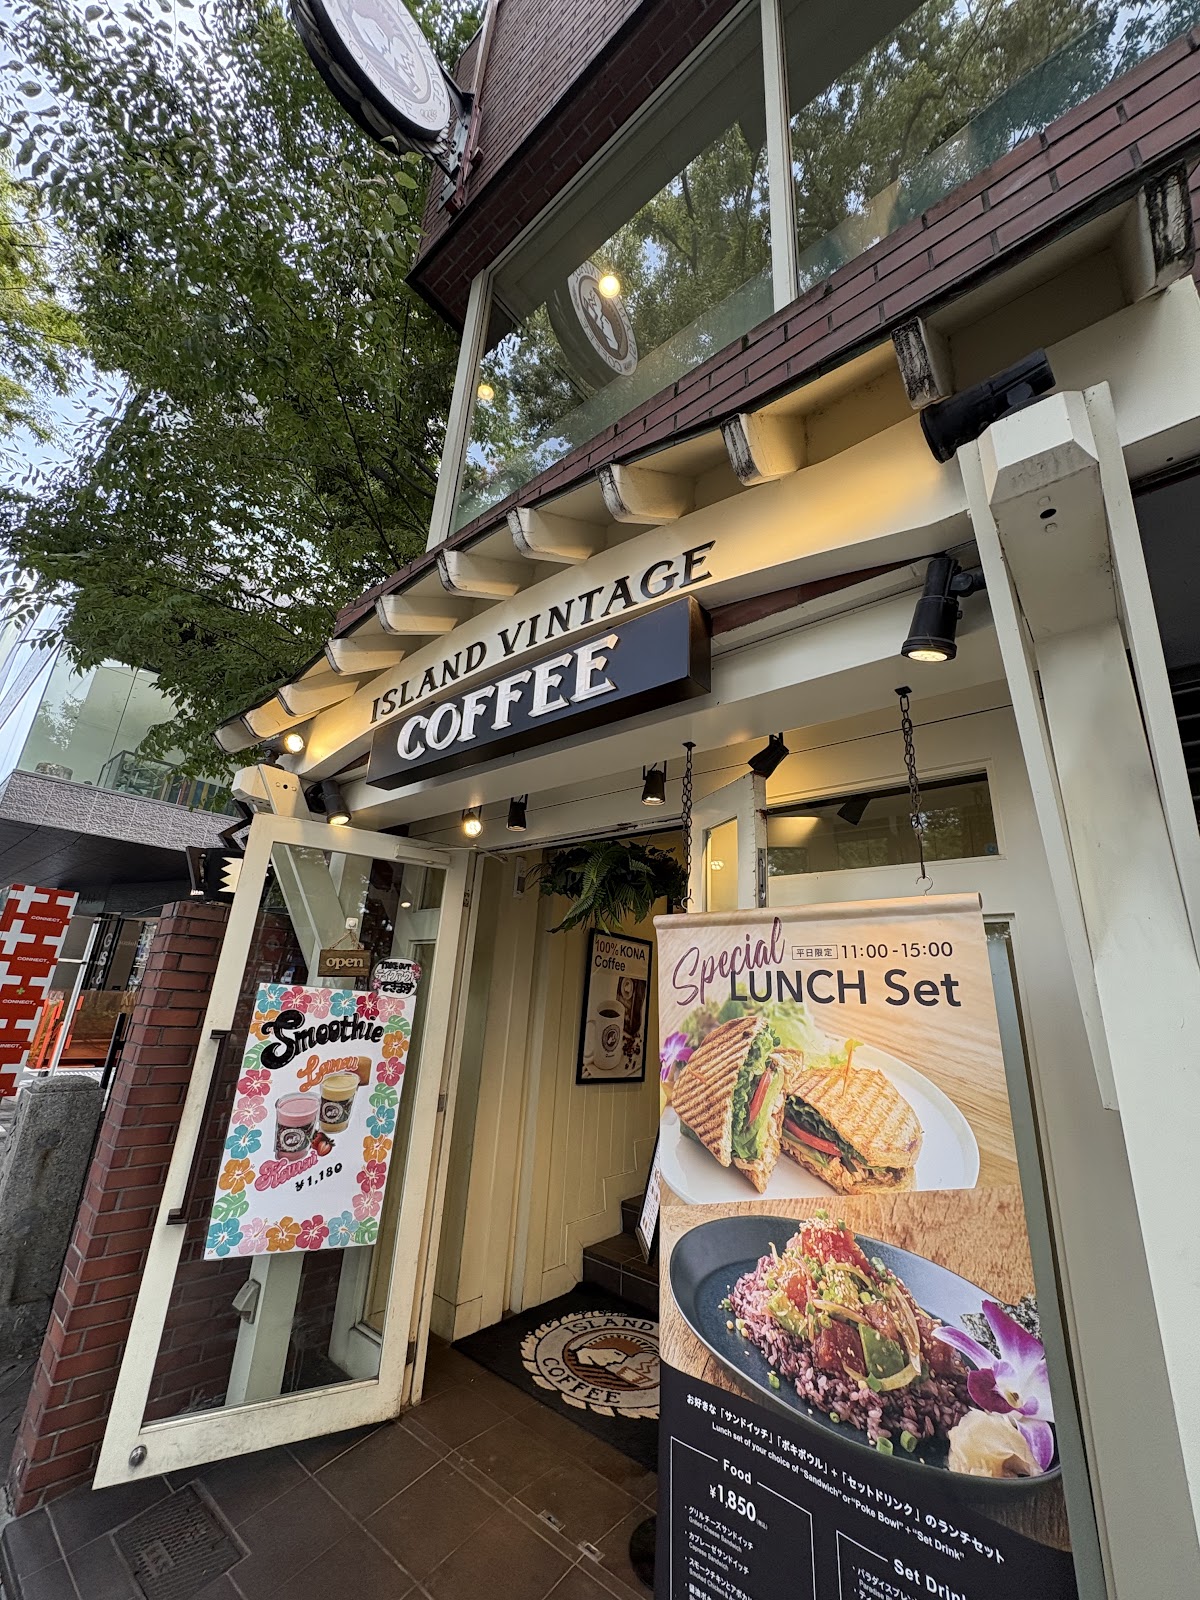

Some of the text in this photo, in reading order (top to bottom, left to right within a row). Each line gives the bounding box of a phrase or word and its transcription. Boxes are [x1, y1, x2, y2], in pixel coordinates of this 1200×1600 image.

[336, 18, 418, 120] COFFEE
[370, 540, 716, 724] ISLAND VINTAGE
[397, 633, 620, 761] COFFEE
[326, 957, 364, 970] open
[379, 961, 412, 970] TAKE OUT
[595, 939, 646, 961] 100% KONA
[595, 955, 625, 971] Coffee
[672, 916, 786, 1006] Special
[796, 947, 833, 958] 平日限定
[381, 981, 415, 994] できます
[730, 968, 962, 1007] LUNCH Set
[260, 1009, 385, 1070] Smoothie
[563, 1318, 655, 1336] ISLAND
[542, 1357, 622, 1404] COFFEE
[711, 1421, 732, 1438] Lunch
[733, 1431, 744, 1444] set
[744, 1438, 752, 1447] of
[752, 1443, 767, 1457] your
[768, 1451, 790, 1468] choice
[791, 1463, 799, 1474] of
[723, 1458, 752, 1485] Food
[709, 1484, 756, 1522] ¥1,850
[893, 1558, 921, 1586] Set
